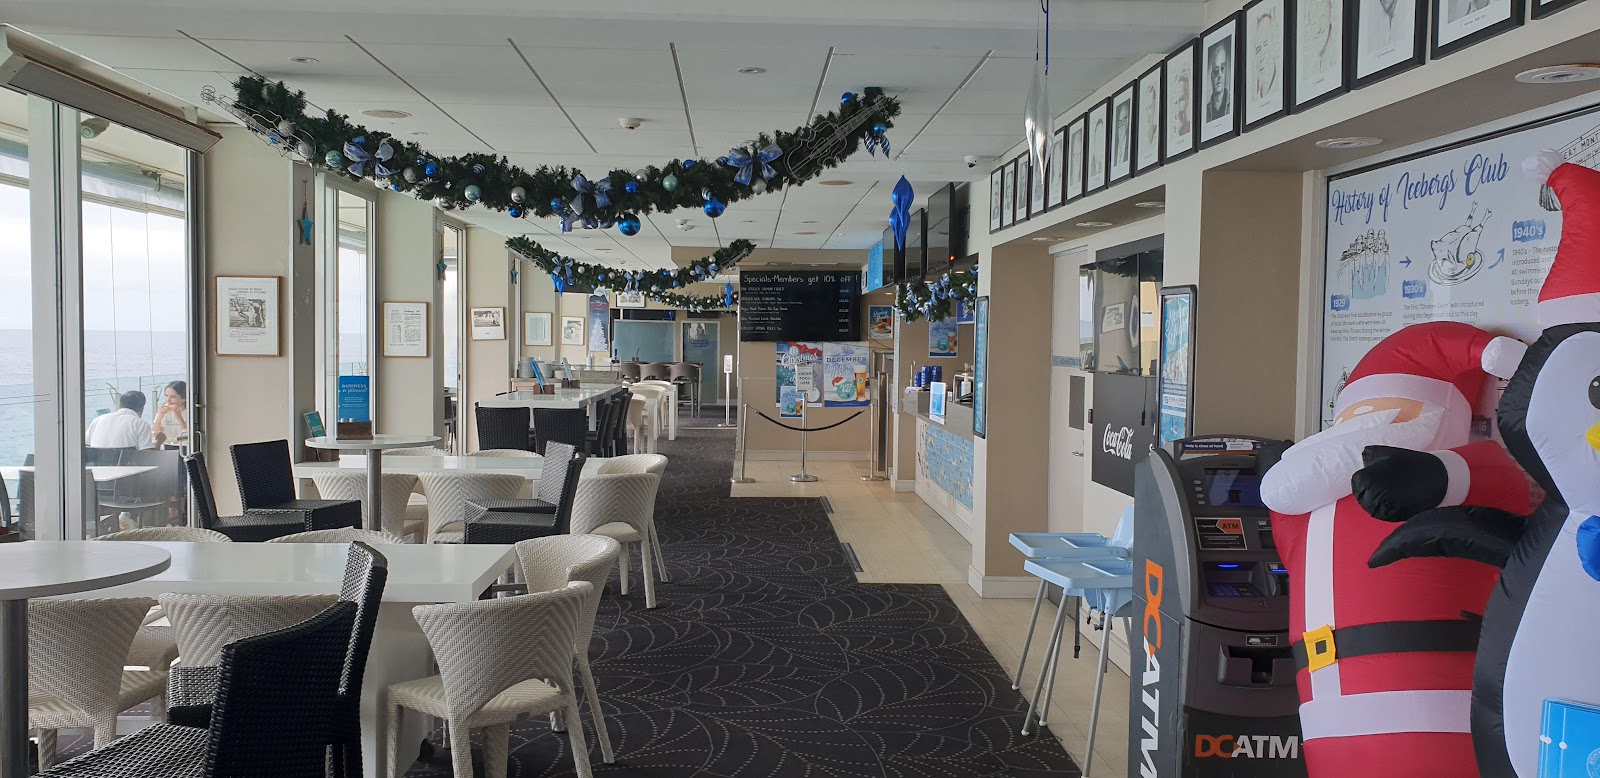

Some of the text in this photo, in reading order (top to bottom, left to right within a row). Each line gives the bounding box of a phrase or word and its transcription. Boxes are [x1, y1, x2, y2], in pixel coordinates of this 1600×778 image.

[1580, 132, 1600, 151] MONT
[1332, 152, 1510, 225] History of Icebergs Club
[1513, 225, 1544, 239] 1940's
[807, 275, 820, 286] get
[823, 274, 836, 283] 10%
[840, 275, 851, 283] off
[1139, 558, 1164, 778] DCATM
[1194, 734, 1299, 759] DCATM
